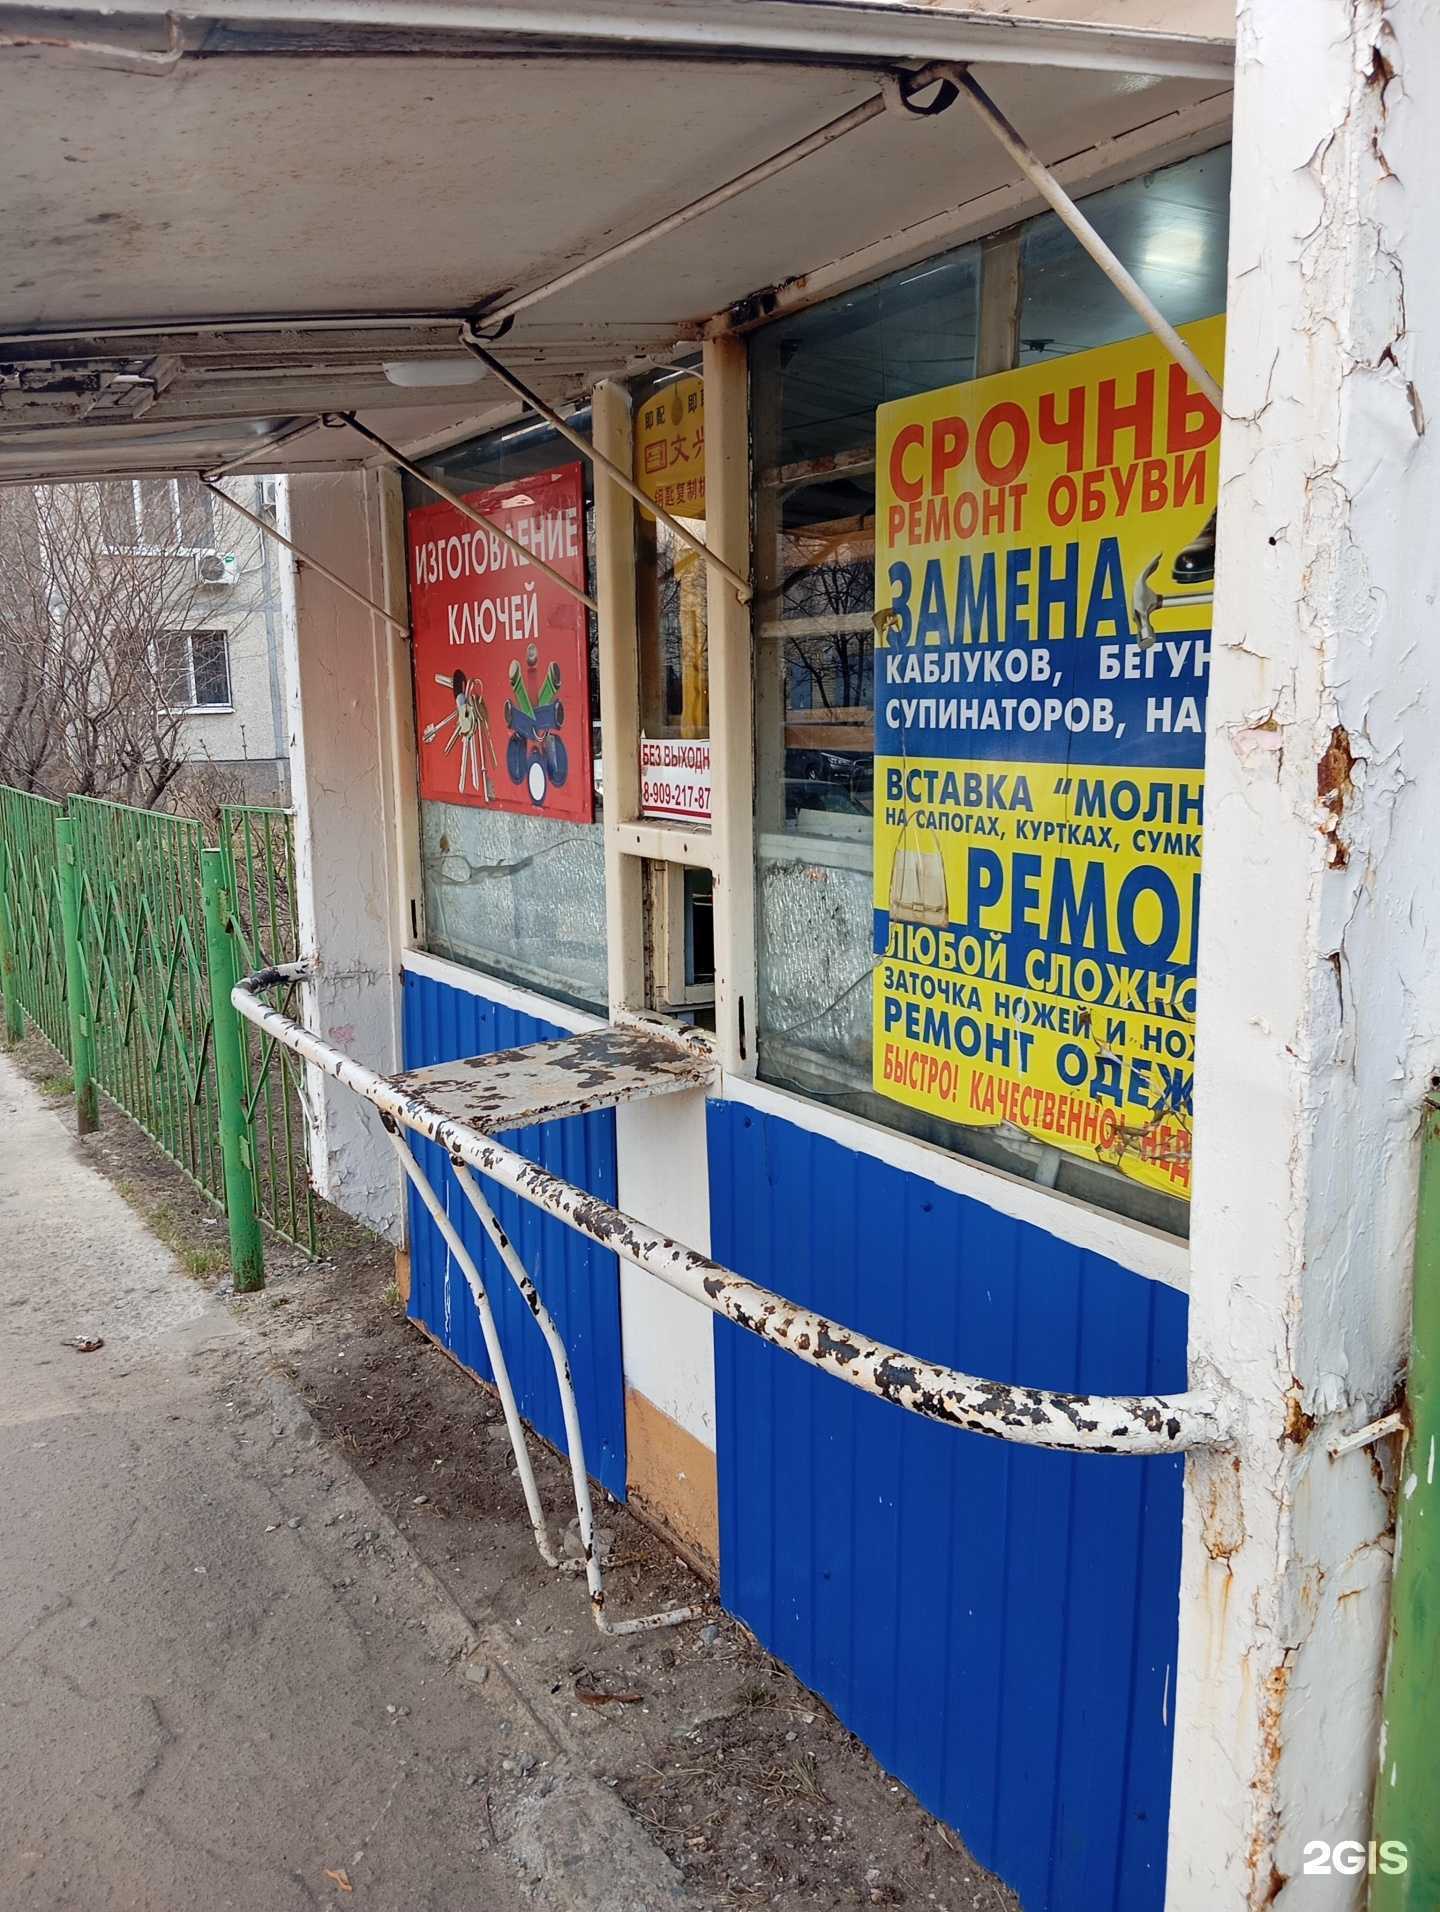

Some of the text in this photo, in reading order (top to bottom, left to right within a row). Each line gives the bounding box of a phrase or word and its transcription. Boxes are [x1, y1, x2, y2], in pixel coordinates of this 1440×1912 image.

[887, 451, 1207, 549] РЕМОНТ ОБУВИ
[415, 506, 578, 585] ИЗГОТОВЛЕНИЕ
[447, 580, 540, 646] КЛЮЧЕЙ
[886, 536, 1131, 648] ЗАМЕНА
[886, 648, 1063, 687] КАБЛУКОВ,
[885, 696, 1207, 739] СУПИНАТОРОВ, НА
[642, 744, 661, 767] БЕЗ
[886, 767, 1034, 813] ВСТАВКА
[885, 809, 1202, 858] НА САПОГАХ, КУРТКАХ, СУМК
[966, 846, 1201, 970] РЕМО
[884, 922, 1007, 983] ЛЮБОЙ
[883, 966, 983, 1013] ЗАТОЧКА
[994, 992, 1091, 1040] НОЖЕЙ
[1106, 1017, 1126, 1047] И
[883, 997, 1035, 1073] РЕМОНТ
[883, 1043, 959, 1103] БЫСТРО!
